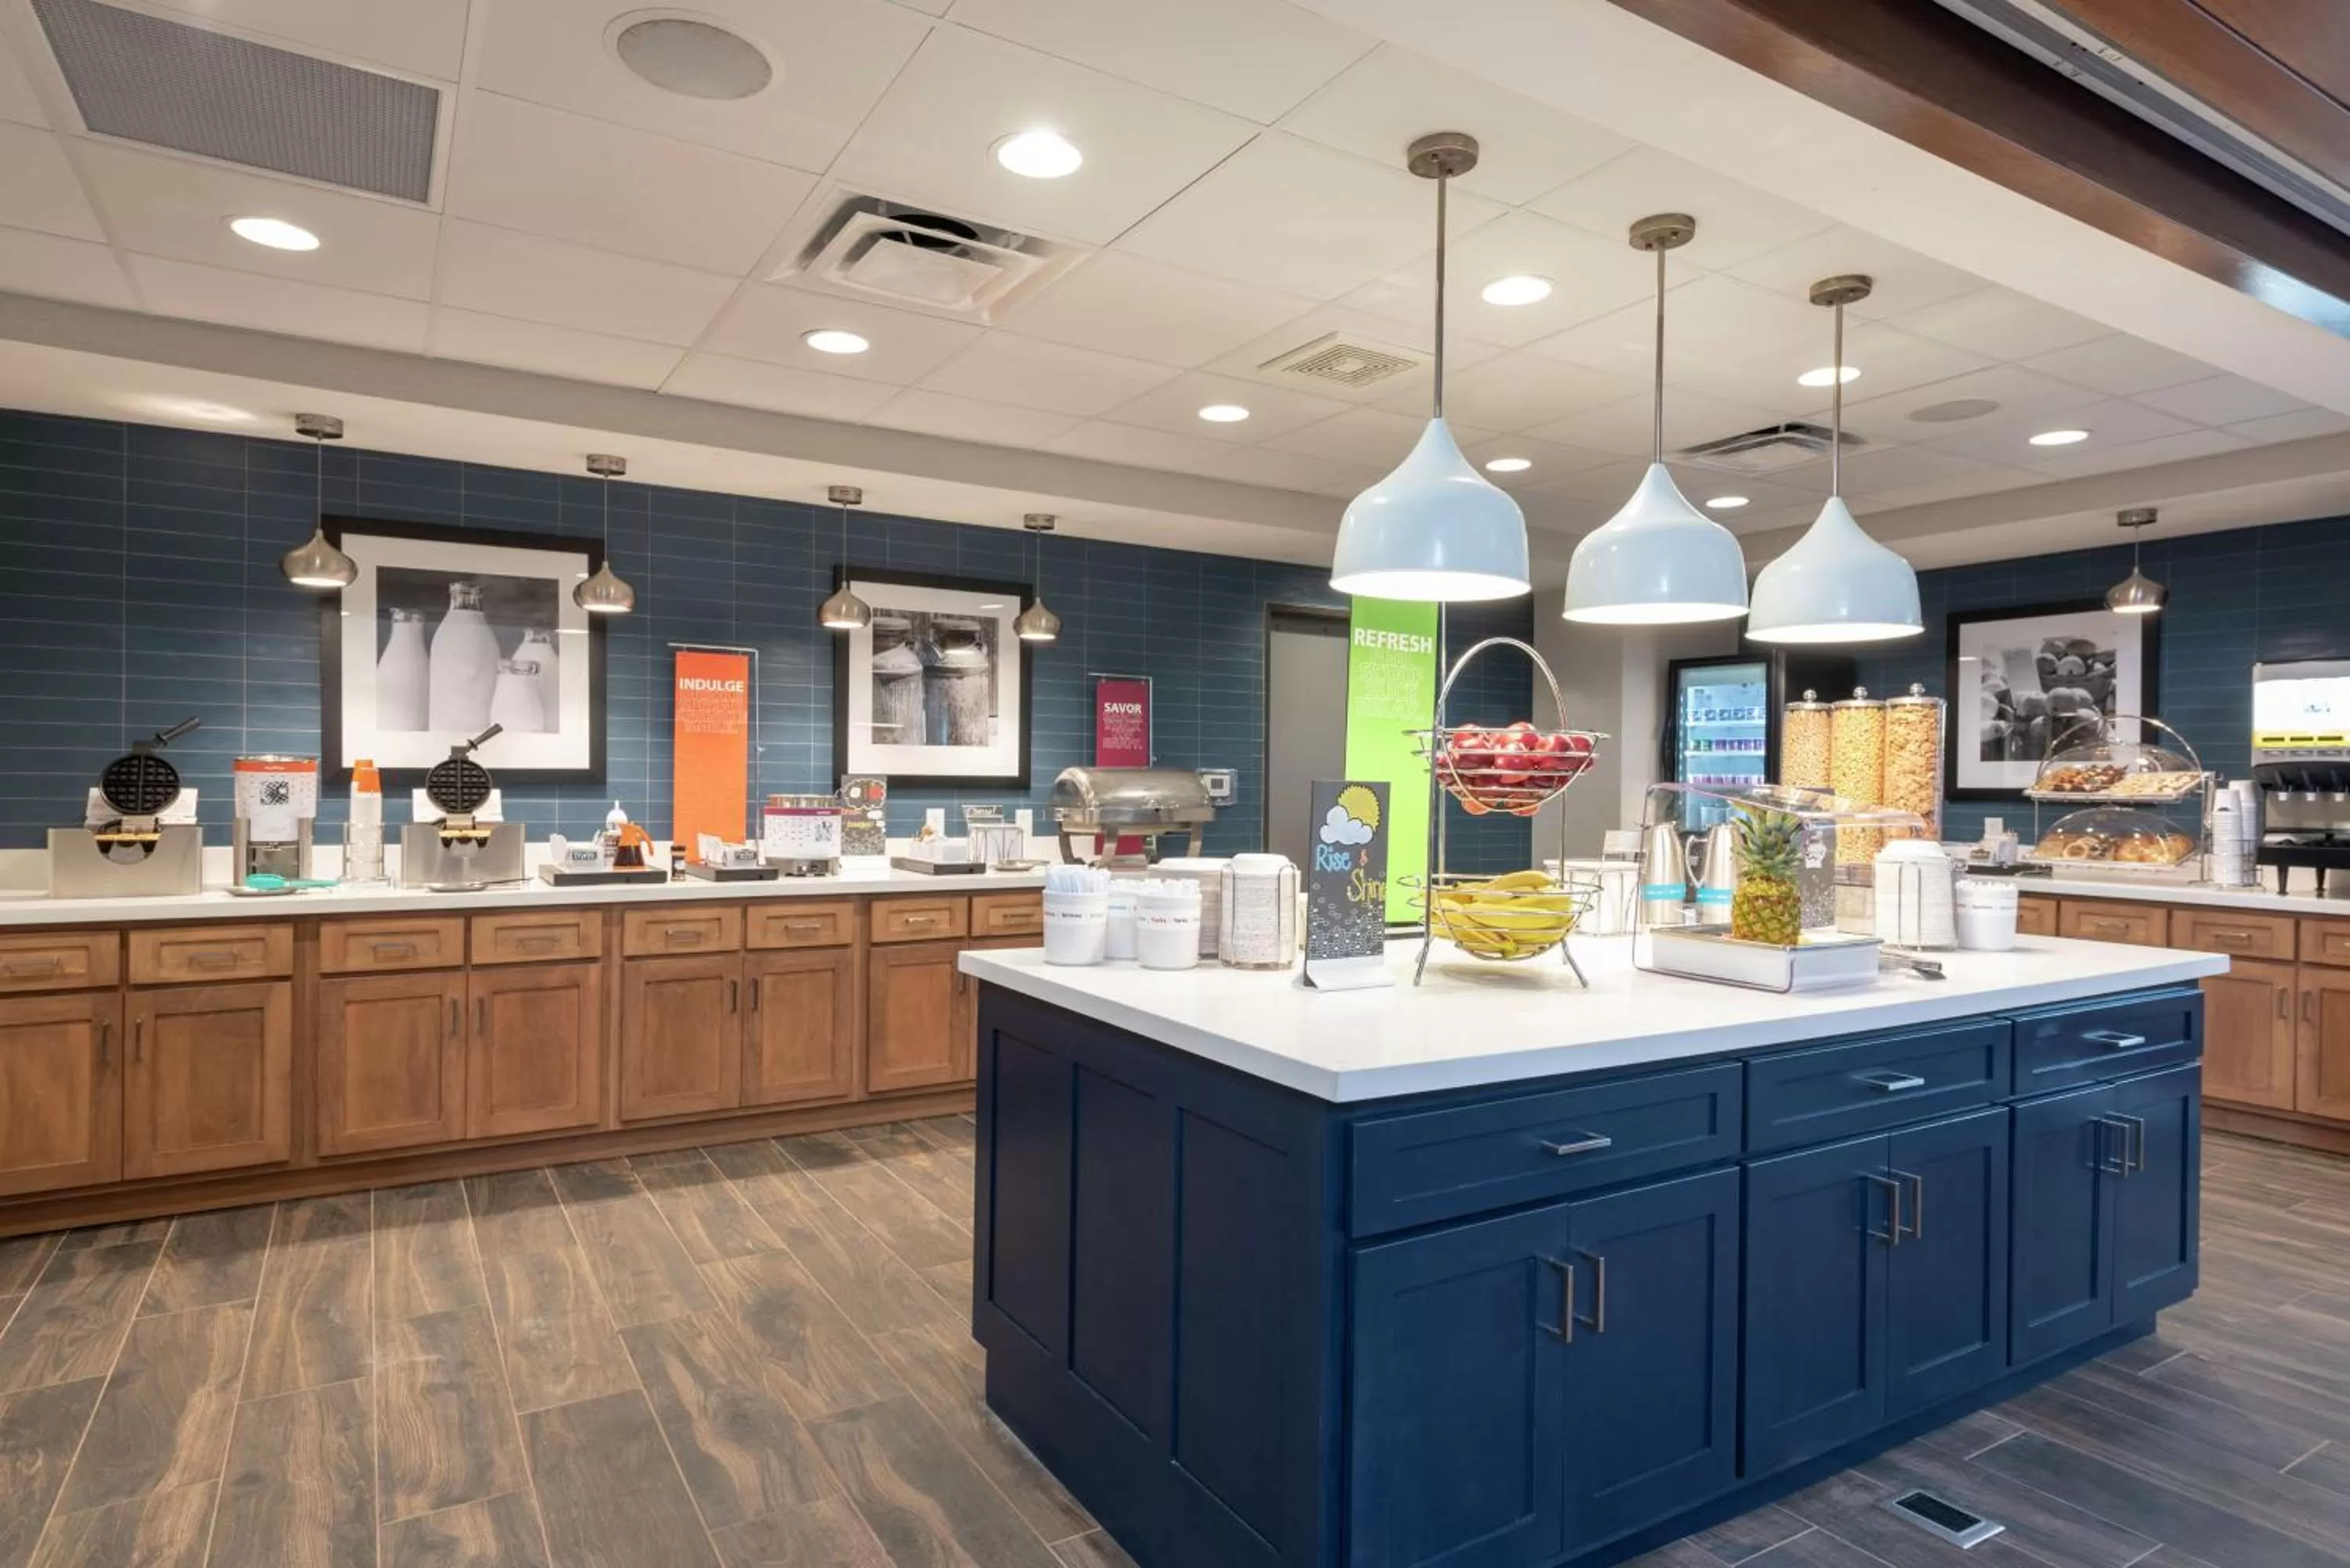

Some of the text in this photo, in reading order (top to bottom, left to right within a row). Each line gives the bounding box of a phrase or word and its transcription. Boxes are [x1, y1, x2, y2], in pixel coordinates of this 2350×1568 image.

[1354, 627, 1433, 653] REFRESH
[679, 677, 745, 692] INDULGE
[1104, 702, 1142, 714] SAVOR
[1315, 844, 1351, 873] Rise
